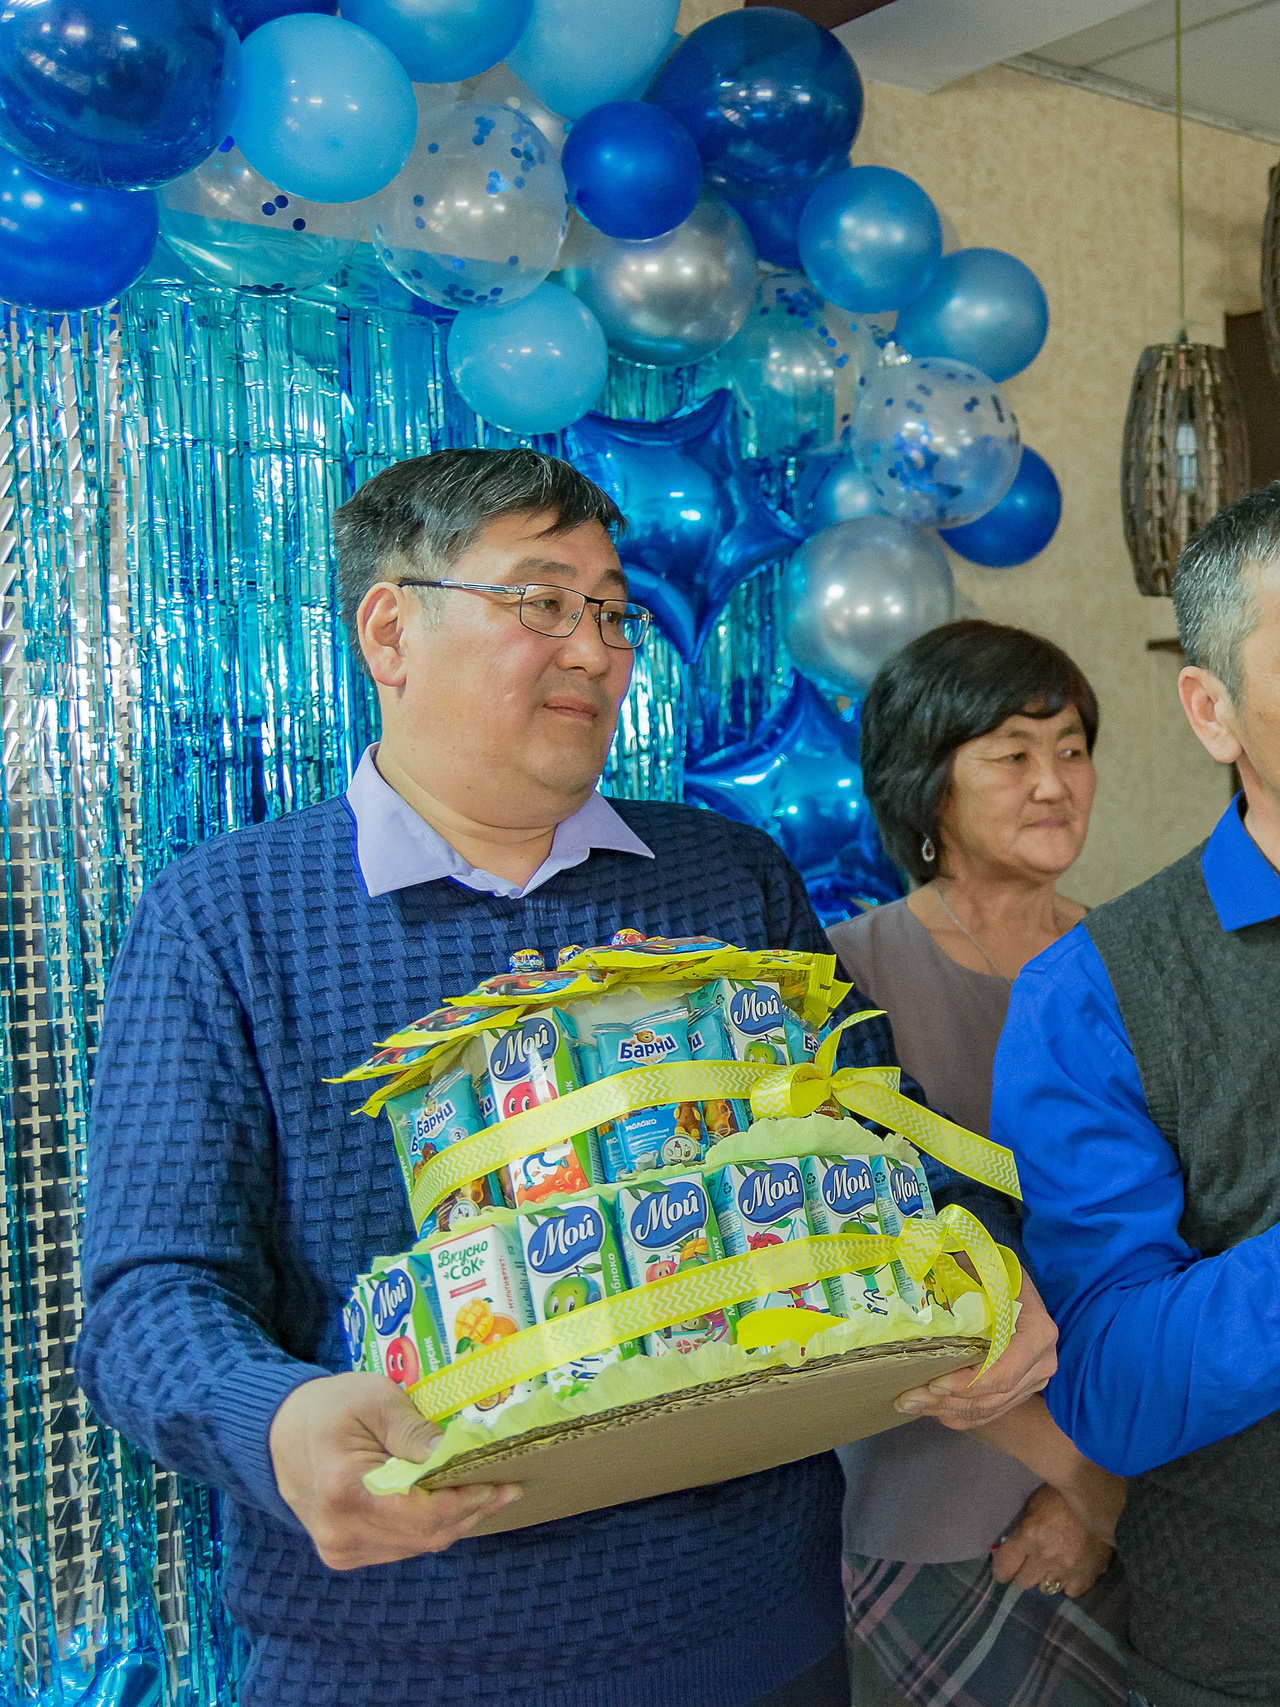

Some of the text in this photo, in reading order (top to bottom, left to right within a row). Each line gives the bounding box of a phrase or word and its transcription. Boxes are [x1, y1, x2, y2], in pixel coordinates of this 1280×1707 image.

[733, 993, 780, 1025] Мой
[494, 1022, 550, 1075] Мой
[620, 1035, 677, 1059] Барни
[416, 1103, 454, 1138] Барни
[742, 1172, 799, 1215] Мой
[826, 1168, 871, 1205] Мой
[893, 1172, 919, 1204] Мой
[634, 1190, 700, 1241] Мой
[532, 1214, 595, 1267] Мой
[374, 1276, 408, 1330] Мой
[424, 1336, 440, 1371] ерсик
